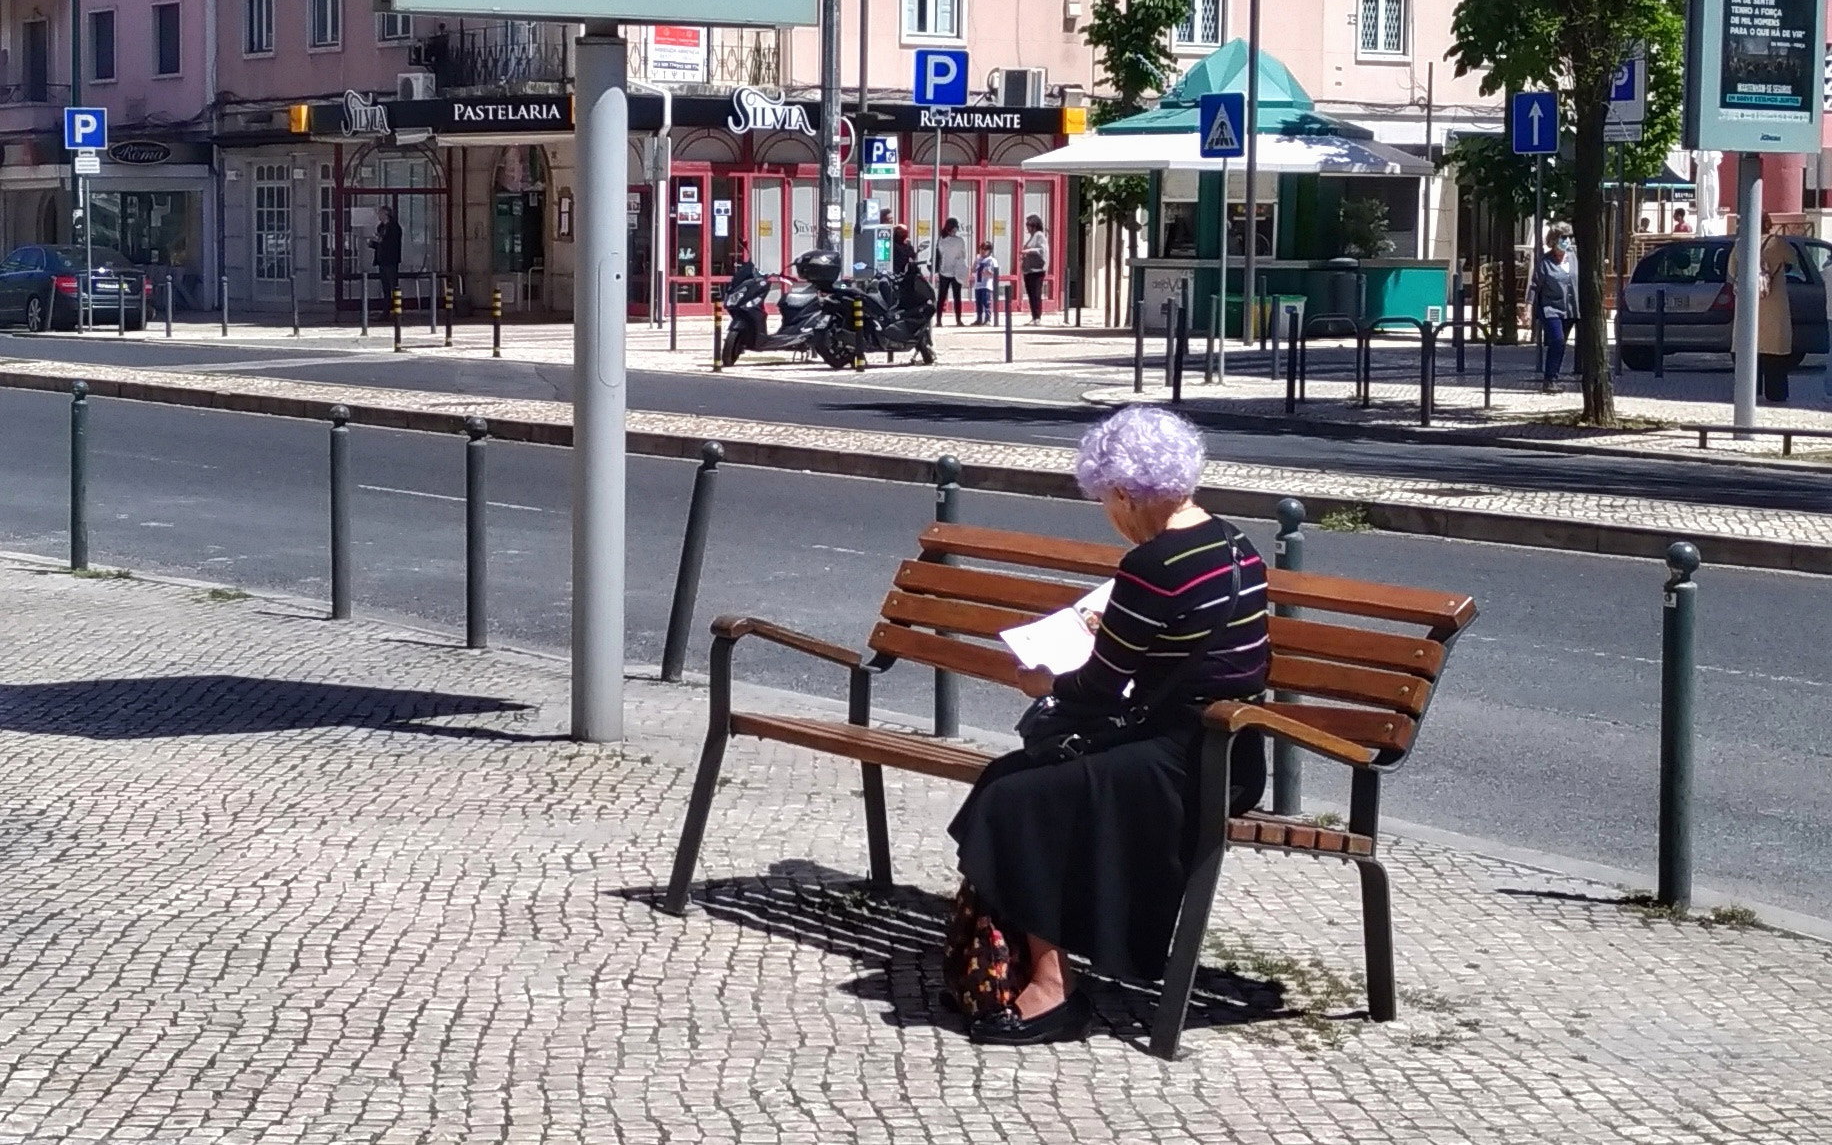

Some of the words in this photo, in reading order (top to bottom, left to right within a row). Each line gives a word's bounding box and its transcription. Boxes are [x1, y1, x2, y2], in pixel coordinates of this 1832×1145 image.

[1730, 16, 1739, 24] DE
[1741, 17, 1752, 25] MIL
[1754, 18, 1780, 26] HOMENS
[1731, 6, 1753, 14] TENHO
[1754, 7, 1760, 15] A
[1761, 8, 1783, 18] FORÇA
[1730, 27, 1748, 35] PARA
[1756, 28, 1770, 36] QUE
[1771, 28, 1781, 37] HÁ
[1782, 29, 1791, 37] DE
[925, 54, 957, 100] P
[75, 114, 97, 143] P
[873, 142, 884, 162] P
[868, 203, 879, 221] P
